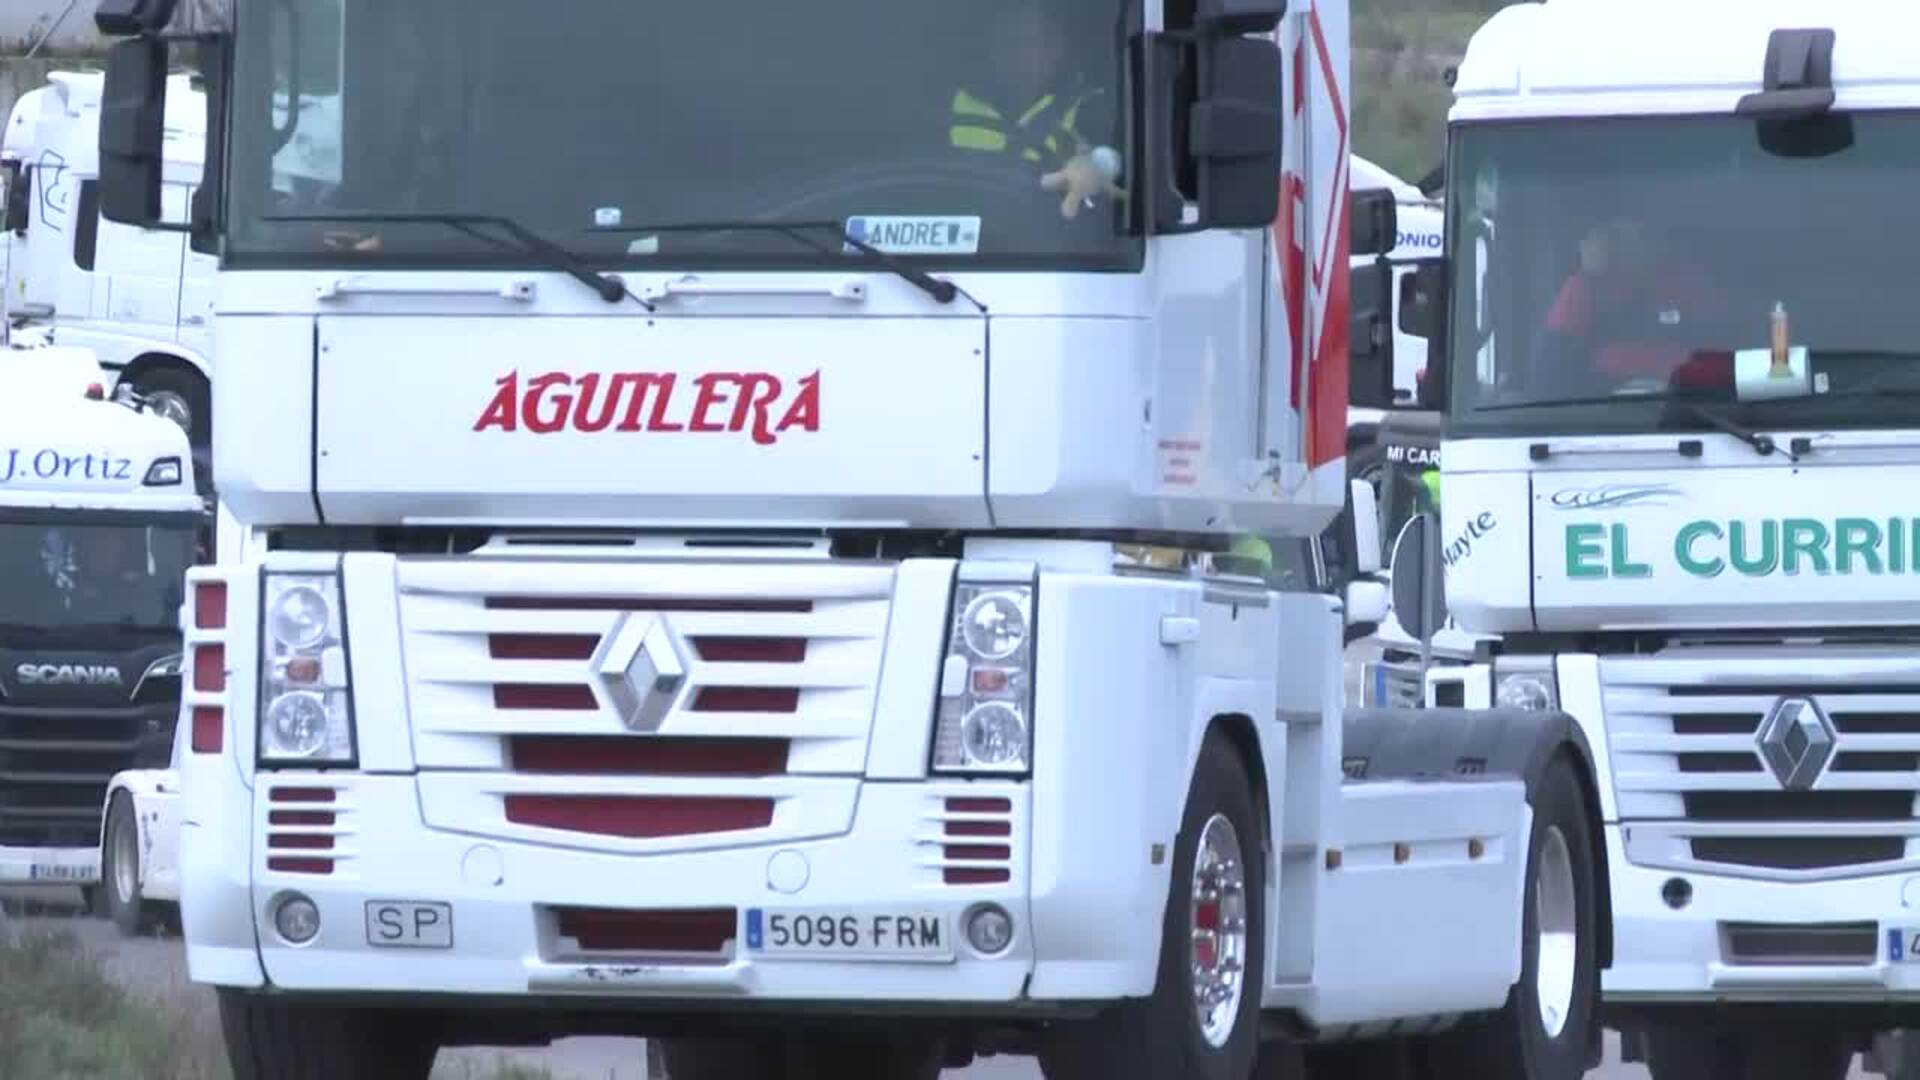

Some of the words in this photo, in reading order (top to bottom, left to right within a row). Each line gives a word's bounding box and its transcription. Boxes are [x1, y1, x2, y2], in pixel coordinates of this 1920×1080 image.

[472, 369, 820, 445] AGUILERA
[1387, 446, 1403, 461] MI
[1565, 522, 1653, 579] EL
[17, 663, 123, 685] SCANIA
[769, 915, 860, 947] 5096
[872, 916, 940, 948] FRM
